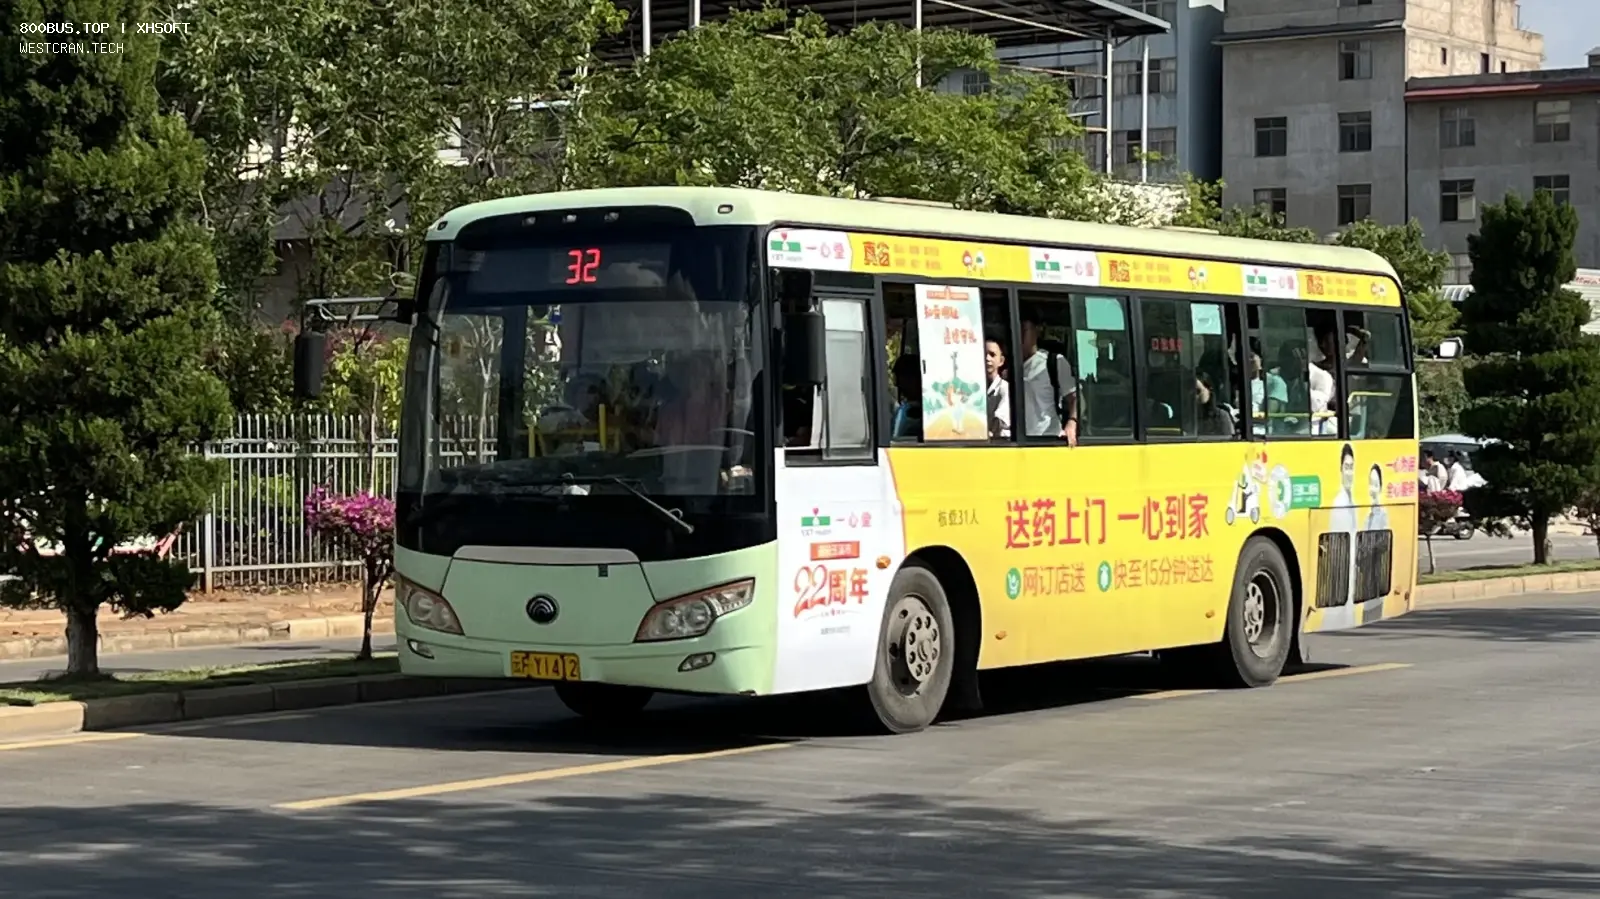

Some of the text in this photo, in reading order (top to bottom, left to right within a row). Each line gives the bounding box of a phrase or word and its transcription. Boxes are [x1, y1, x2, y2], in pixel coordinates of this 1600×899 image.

[565, 248, 601, 284] 32
[1005, 493, 1210, 549] 送药上门 一心到家
[1022, 554, 1214, 597] 网订店送 快至15分钟送达
